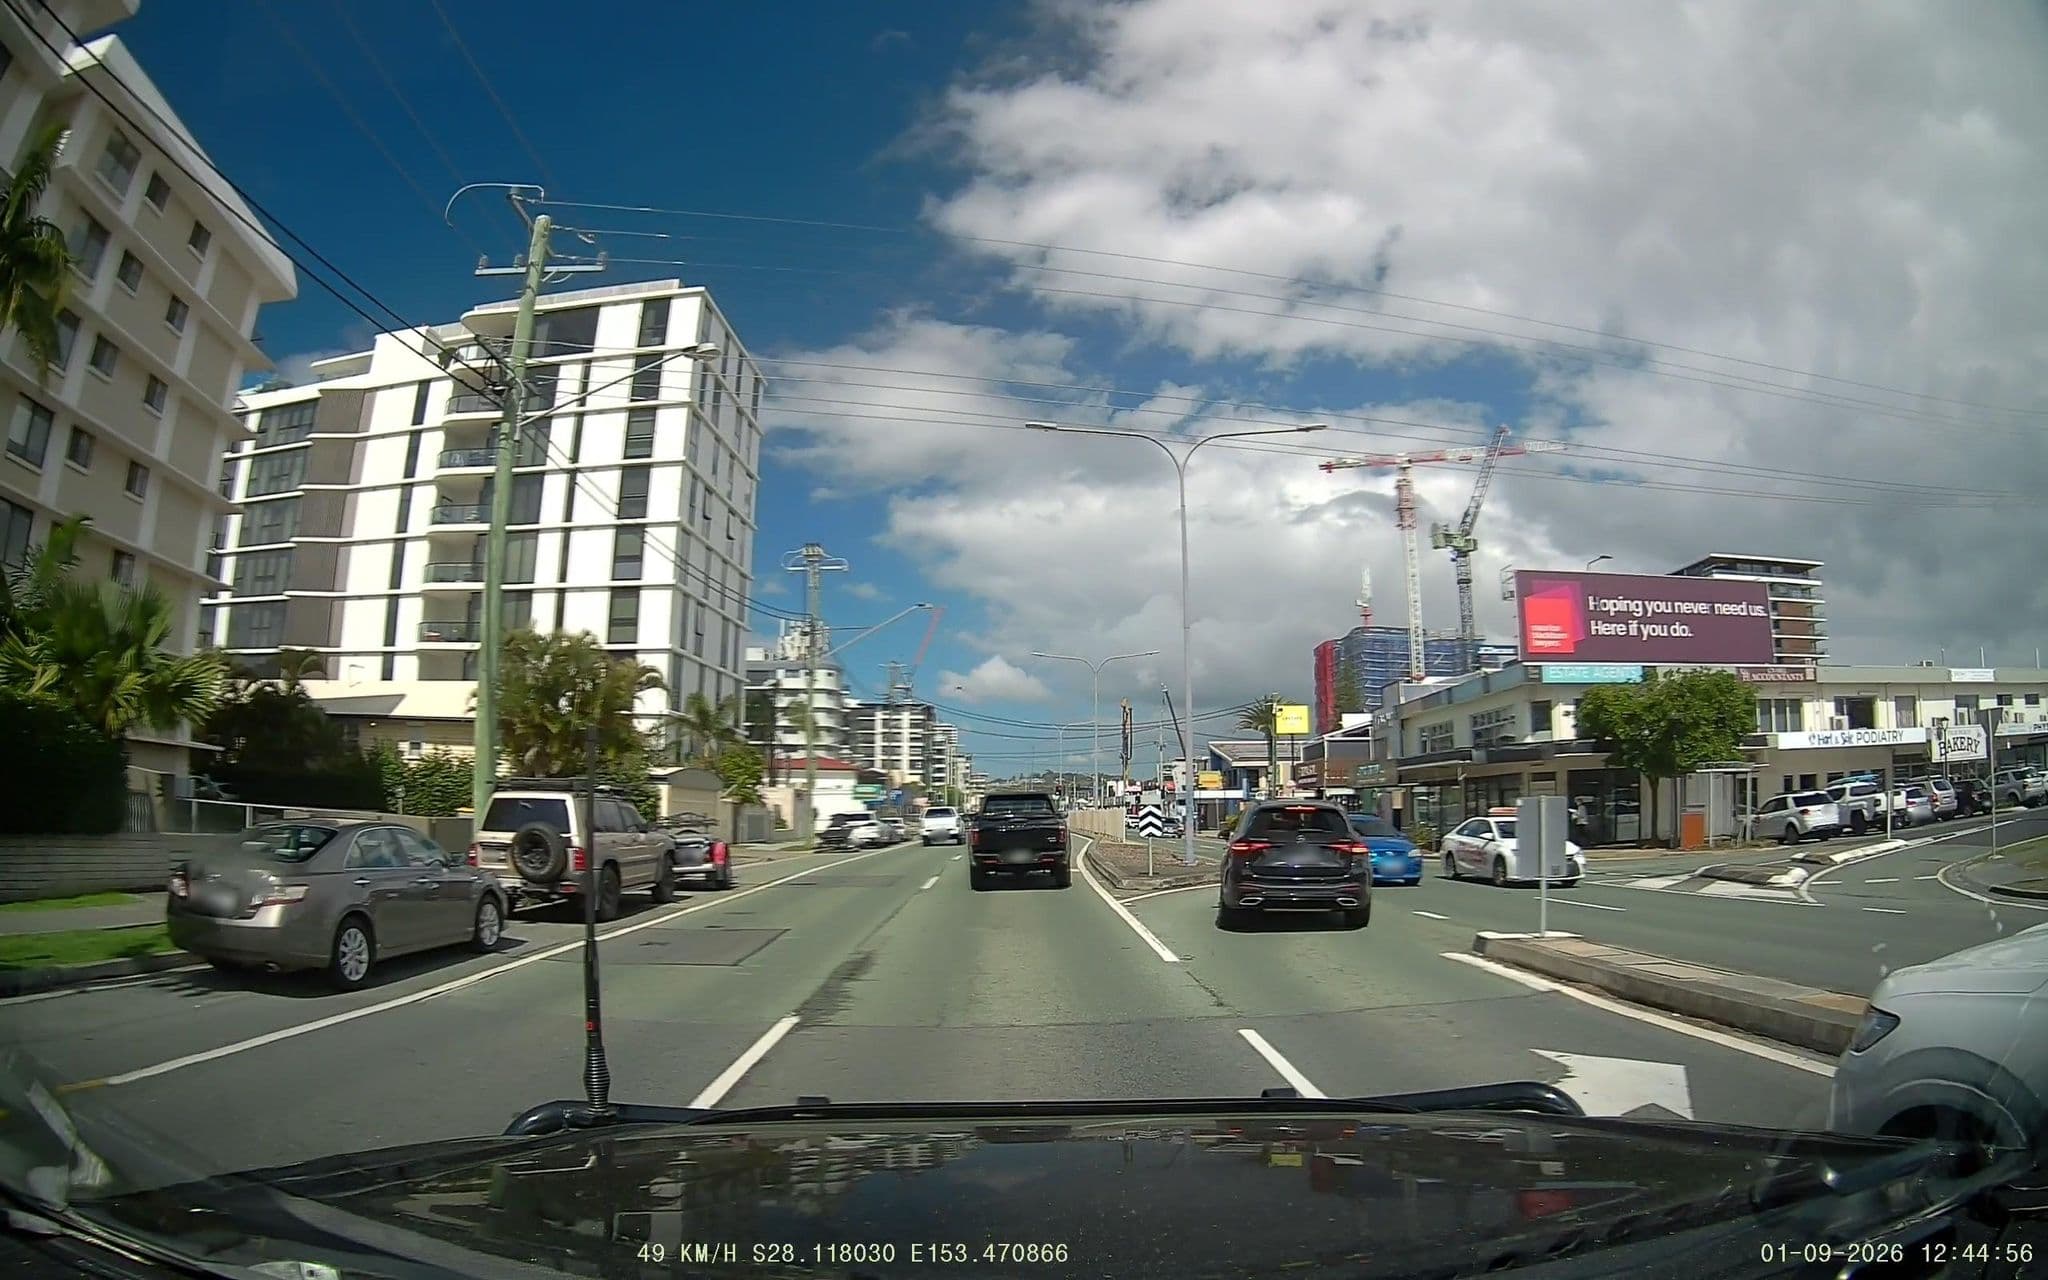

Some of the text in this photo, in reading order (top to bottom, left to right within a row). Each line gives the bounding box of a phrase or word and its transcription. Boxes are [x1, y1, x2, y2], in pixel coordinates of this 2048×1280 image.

[1588, 595, 1769, 617] Hoping you never need us.
[1590, 619, 1694, 641] Here if you do.
[1549, 666, 1591, 678] ESTATE
[1856, 730, 1904, 744] PODIATRY
[1938, 736, 1981, 756] BAKERY
